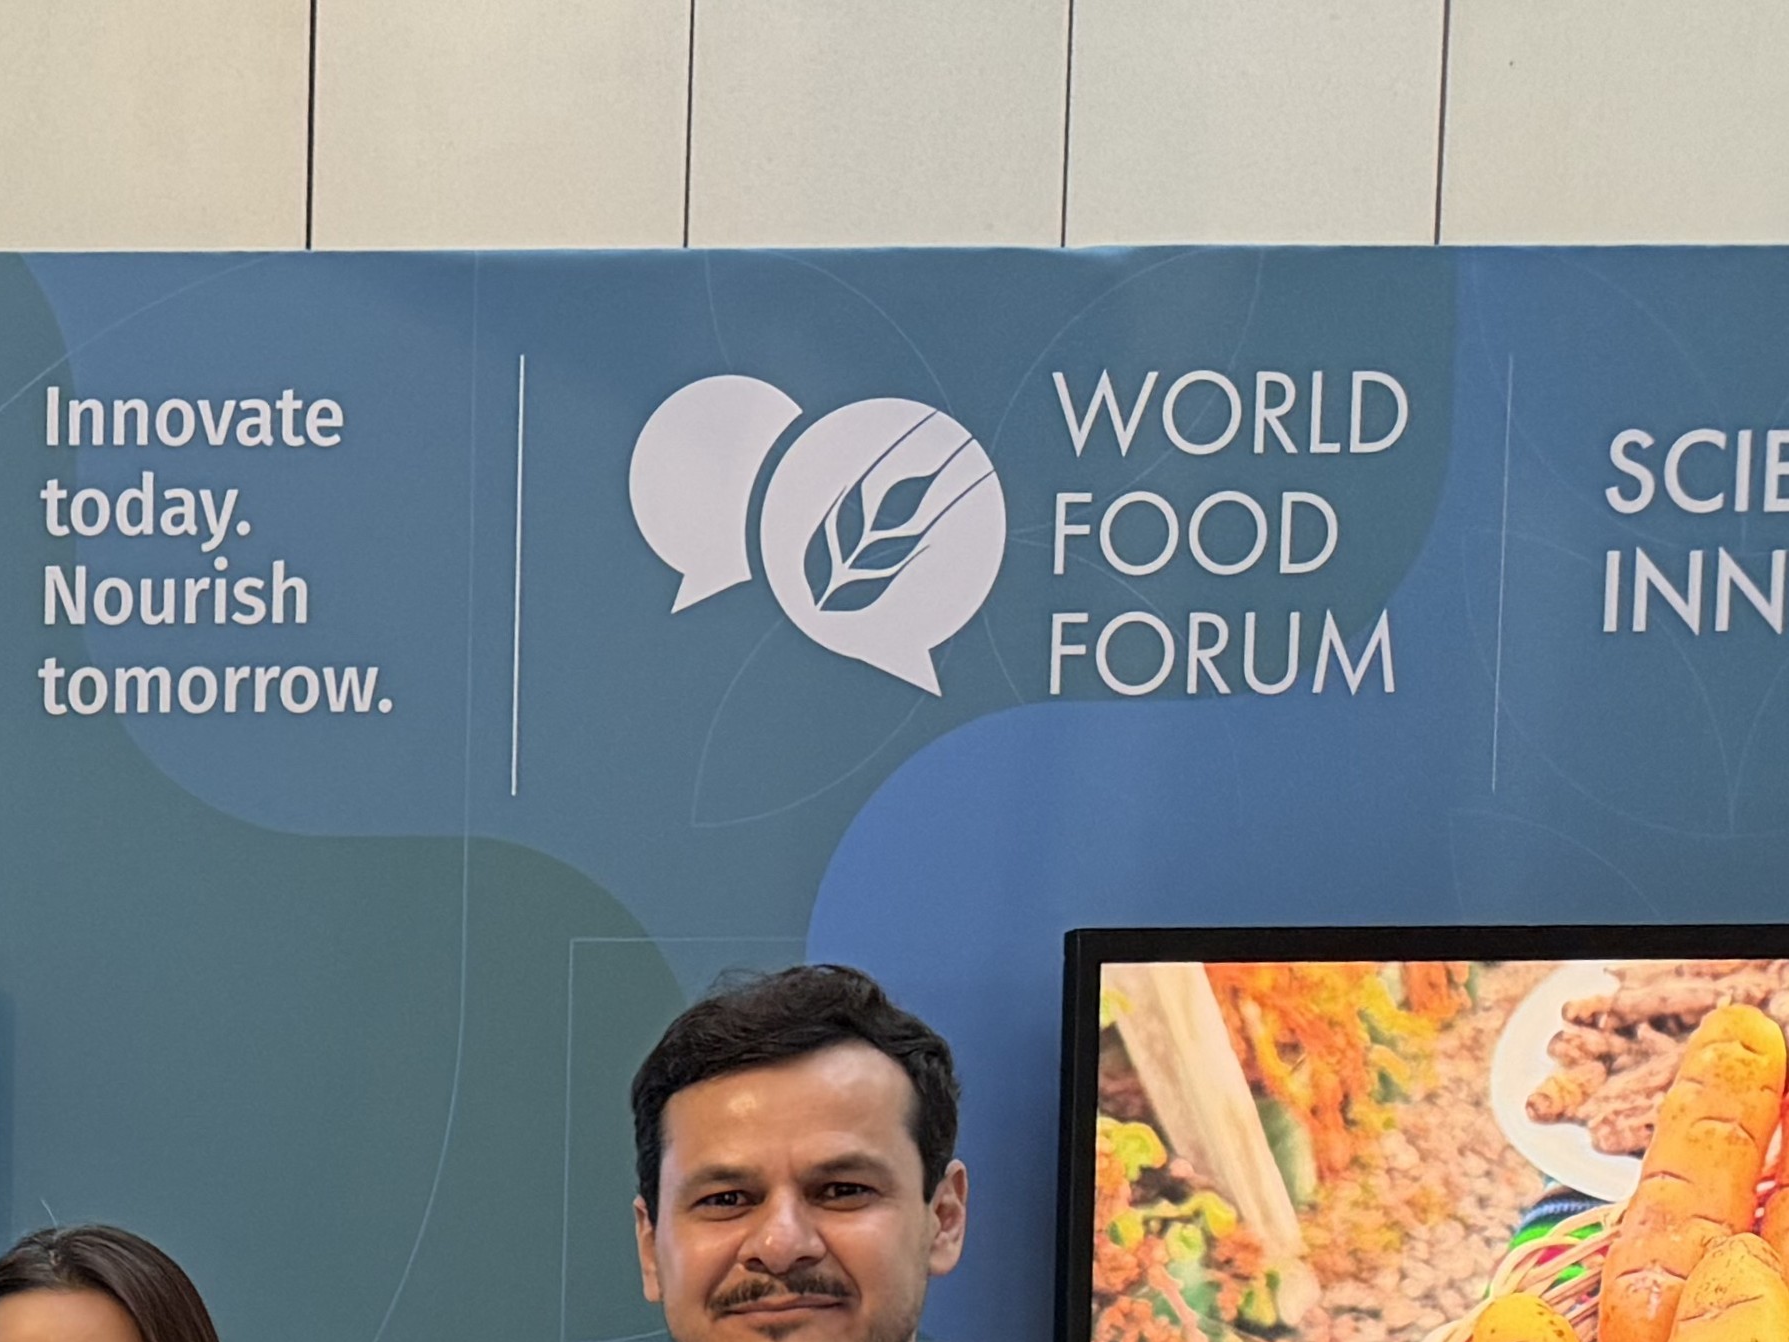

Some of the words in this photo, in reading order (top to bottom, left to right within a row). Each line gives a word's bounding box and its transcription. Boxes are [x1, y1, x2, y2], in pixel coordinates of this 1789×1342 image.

[43, 385, 345, 452] Innovate
[1054, 369, 1410, 459] WORLD
[42, 469, 252, 545] today.
[1605, 428, 1789, 514] SCIE
[1055, 490, 1340, 577] FOOD
[43, 557, 310, 630] Nourish
[1603, 546, 1786, 636] INN
[37, 654, 395, 717] tomorrow.
[1049, 606, 1398, 697] FORUM
